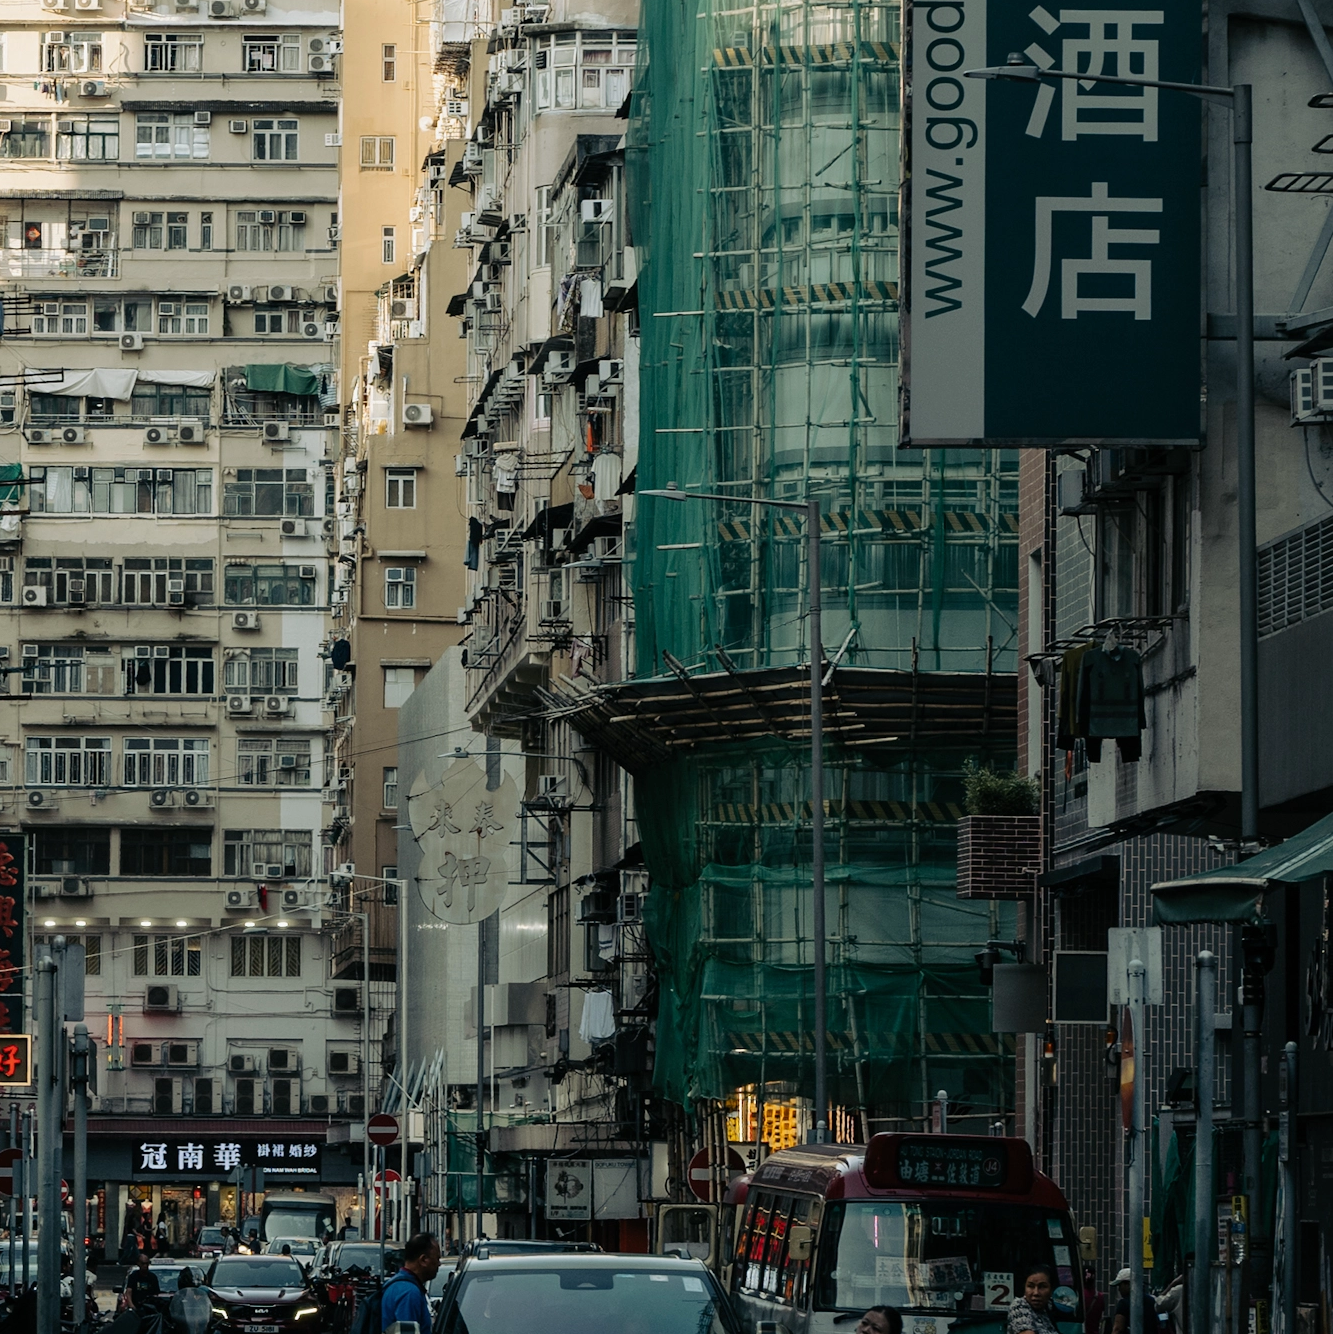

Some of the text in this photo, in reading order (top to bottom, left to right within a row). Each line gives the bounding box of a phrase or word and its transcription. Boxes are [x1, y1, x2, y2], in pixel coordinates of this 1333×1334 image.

[437, 851, 491, 912] 押
[140, 1142, 242, 1170] 冠南華
[985, 1161, 998, 1173] J4
[899, 1159, 930, 1183] 油塘
[990, 1284, 1010, 1306] 2
